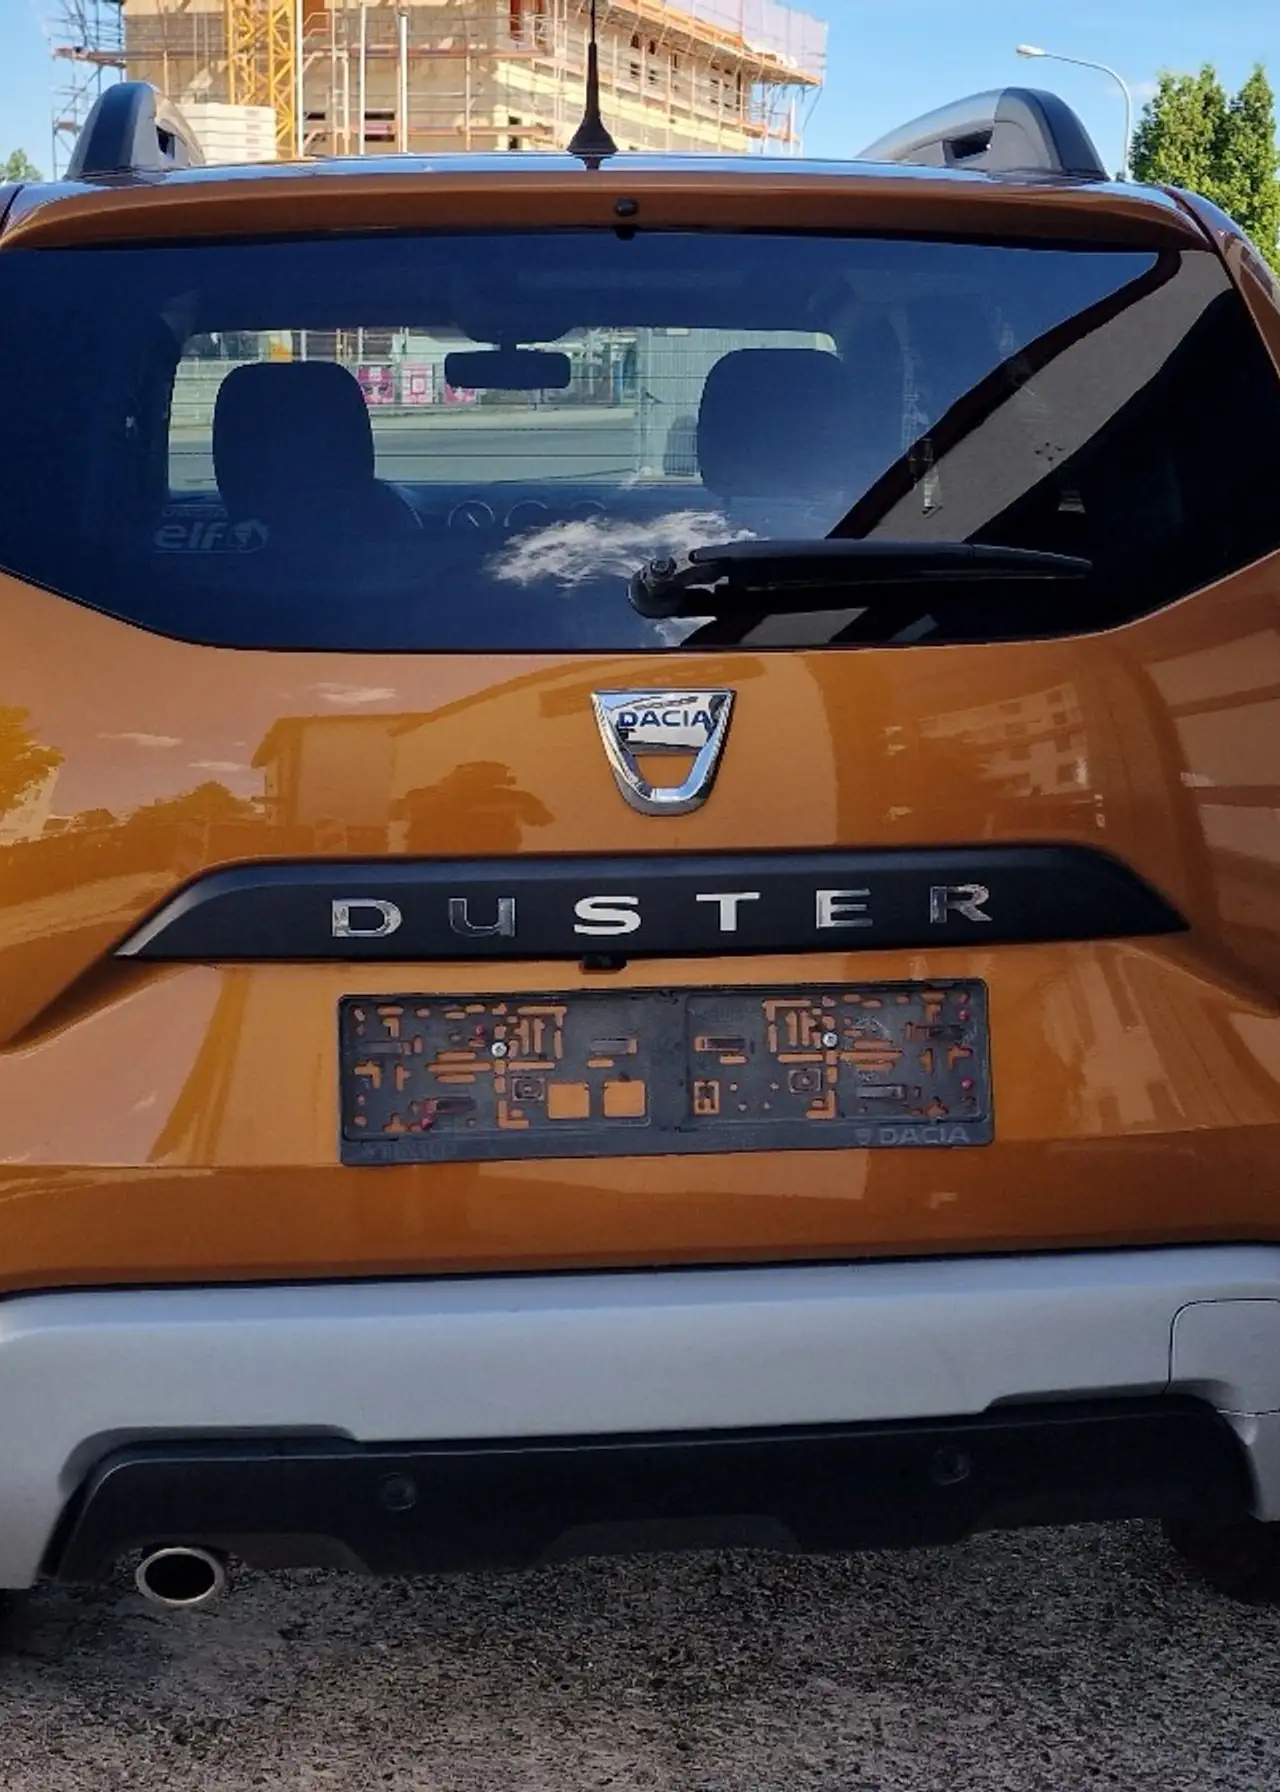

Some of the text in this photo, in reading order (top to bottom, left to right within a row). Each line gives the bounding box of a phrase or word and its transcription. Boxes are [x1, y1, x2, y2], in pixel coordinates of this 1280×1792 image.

[153, 521, 229, 550] elf
[619, 709, 712, 728] DACIA
[331, 884, 993, 938] DUSTER
[879, 1125, 971, 1145] DACIA
